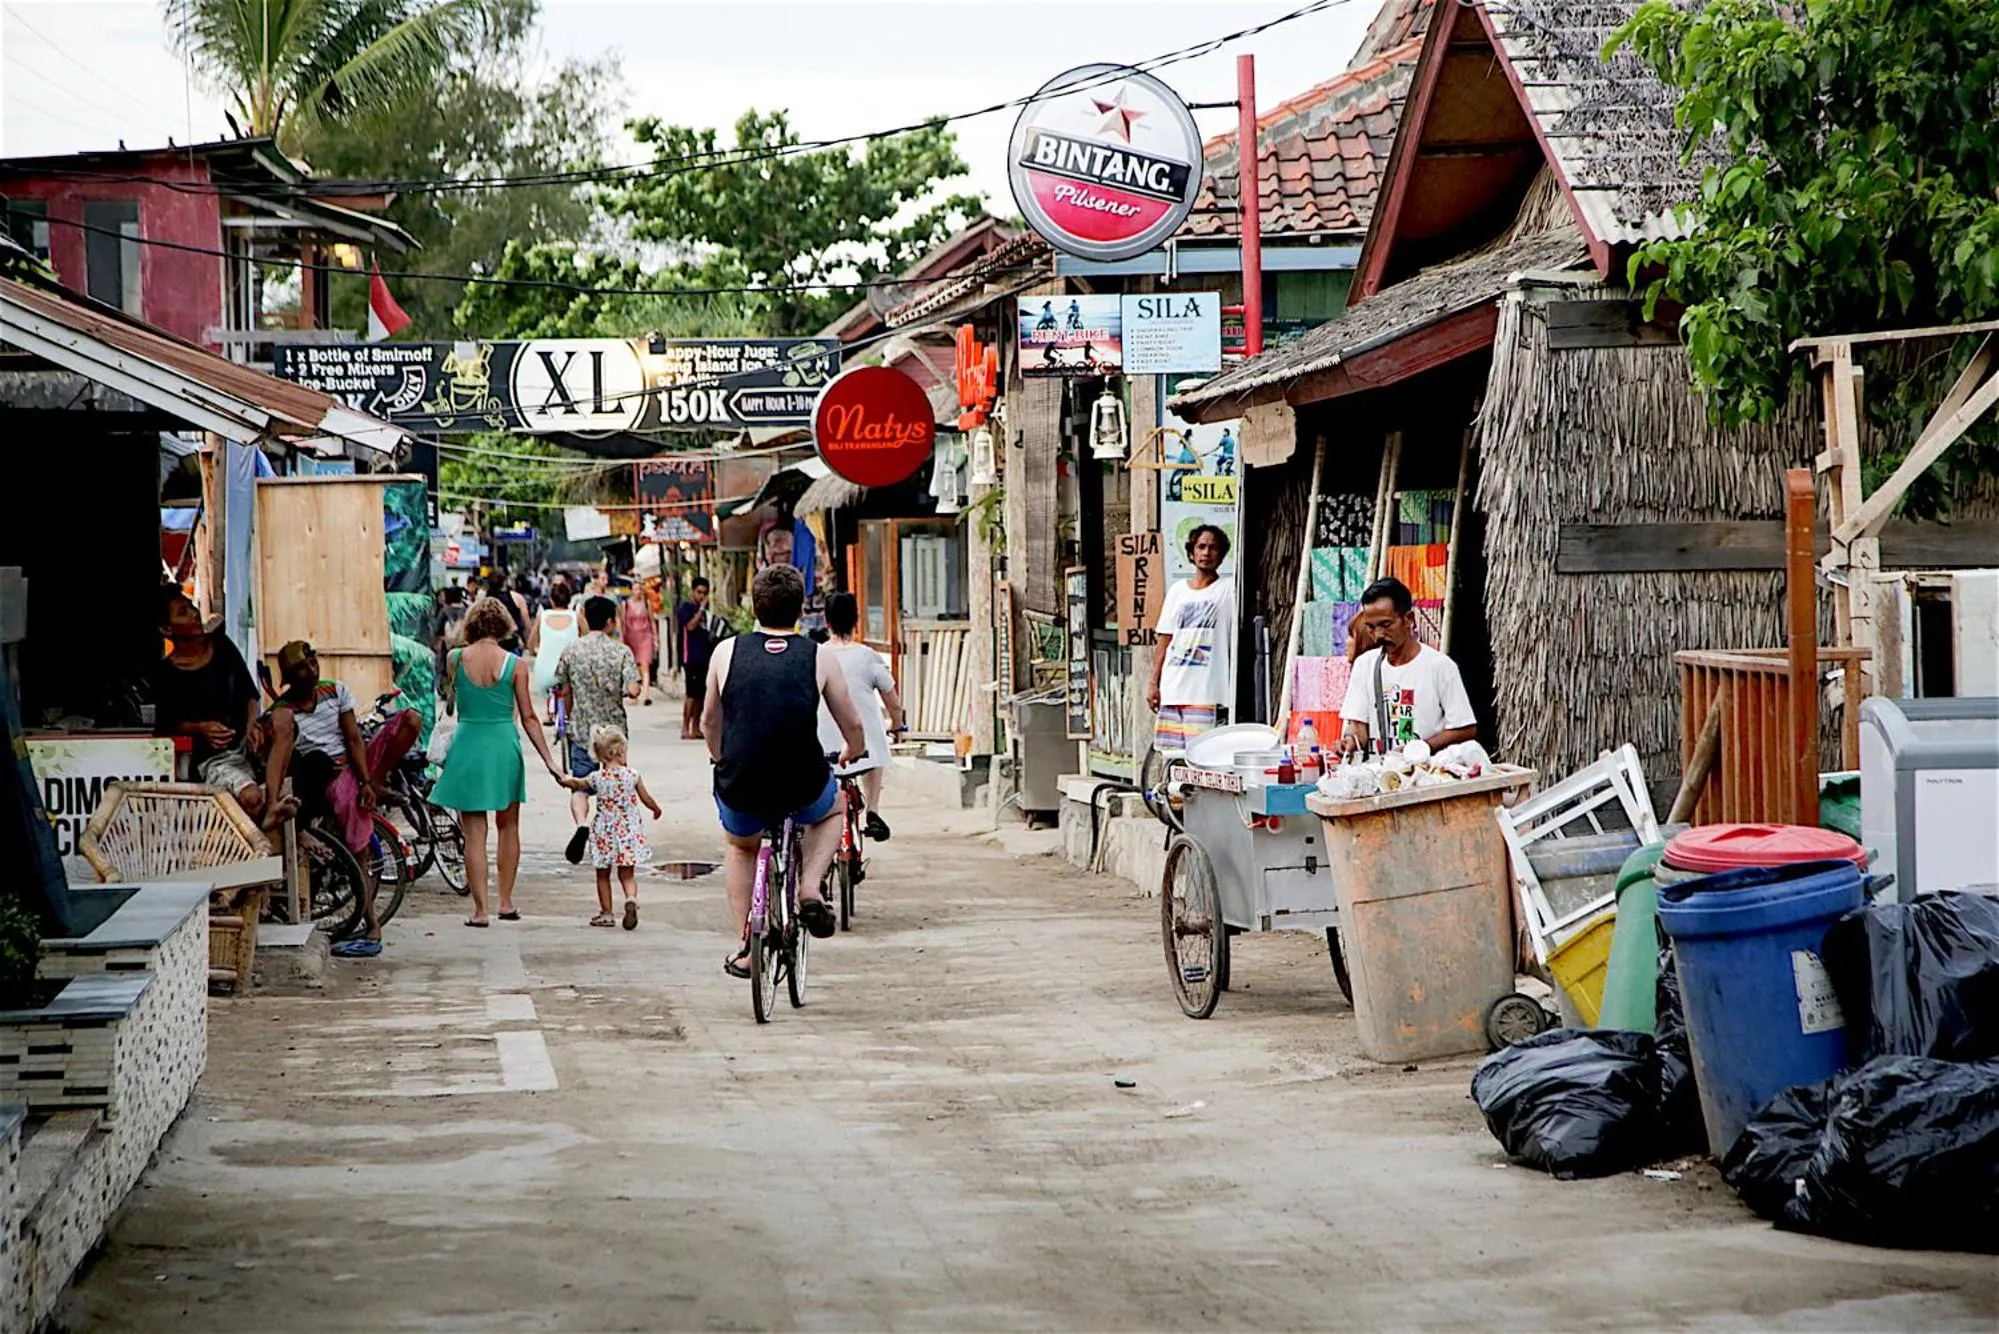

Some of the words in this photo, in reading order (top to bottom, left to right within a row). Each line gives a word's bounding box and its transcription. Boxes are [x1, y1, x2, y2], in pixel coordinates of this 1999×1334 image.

[1033, 134, 1170, 191] BINTANG
[1054, 183, 1142, 217] Pilsener
[1137, 297, 1202, 319] SILA
[1031, 328, 1071, 341] RENT
[1073, 327, 1110, 341] BIKE
[285, 348, 293, 362] 1
[297, 351, 306, 362] x
[308, 348, 350, 362] Bottle
[354, 347, 369, 362] of
[372, 347, 433, 362] Smirnoff
[665, 345, 741, 361] appy-Hour
[744, 345, 779, 361] Jugs:
[298, 363, 307, 376] 2
[311, 363, 344, 376] Free
[347, 362, 395, 376] Mixers
[695, 358, 739, 372] Island
[741, 359, 763, 372] Ice
[298, 377, 376, 391] Ice-Bucket
[394, 373, 422, 408] ONLY
[536, 351, 626, 415] XL
[657, 376, 674, 387] or
[657, 387, 732, 423] 150K
[741, 396, 764, 411] HAPPY
[765, 395, 786, 411] HOUR
[827, 404, 926, 449] Natys
[1121, 534, 1159, 555] SILA
[1133, 556, 1149, 629] RENT
[1127, 628, 1158, 646] BIK
[1391, 719, 1413, 738] TA
